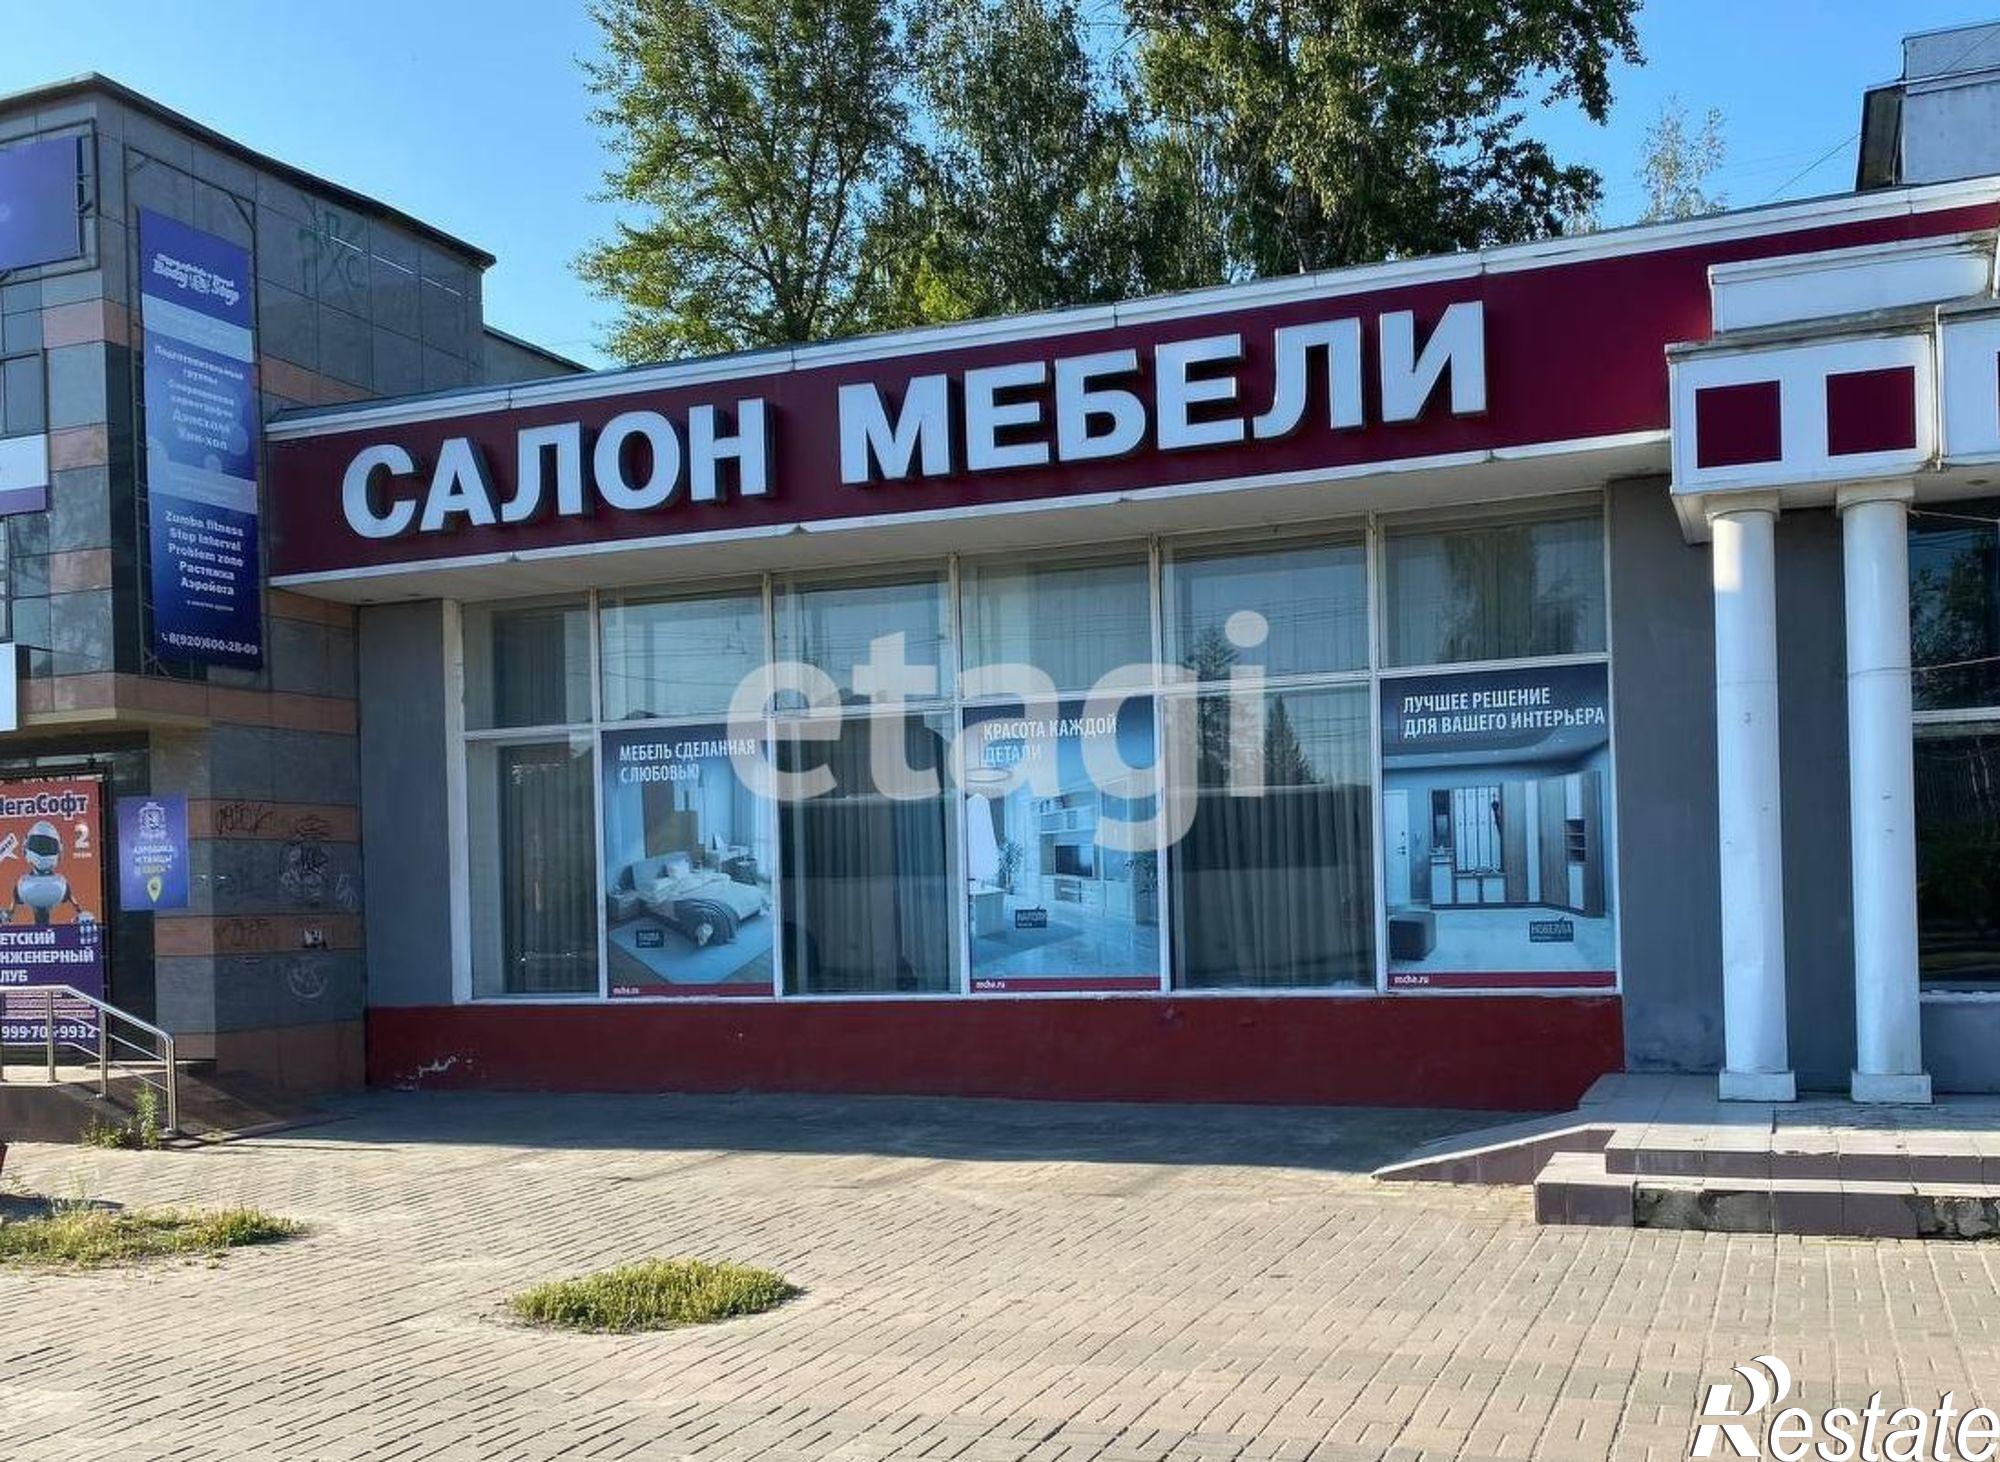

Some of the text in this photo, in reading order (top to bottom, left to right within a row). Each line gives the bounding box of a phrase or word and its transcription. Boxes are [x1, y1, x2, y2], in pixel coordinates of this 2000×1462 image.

[342, 301, 1488, 538] САЛОН МЕБЕЛИ
[165, 510, 204, 528] Zumba
[168, 543, 216, 562] Problem
[180, 561, 235, 580] Растяжка
[181, 577, 235, 596] Аэройога
[1403, 687, 1550, 714] ЛУЧШЕЕ РЕШЕНИЕ
[983, 714, 1117, 741] КРАСОТА КАЖДОЙ
[1404, 707, 1606, 739] ДЛЯ ВАШЕГО ИНТЕРЬЕРА
[619, 739, 756, 762] МЕБЕЛЬ СДЕЛАННАЯ
[983, 744, 1042, 766] ДЕТАЛИ
[630, 764, 700, 782] ЛЮБОВЬЮ
[75, 823, 89, 848] 2
